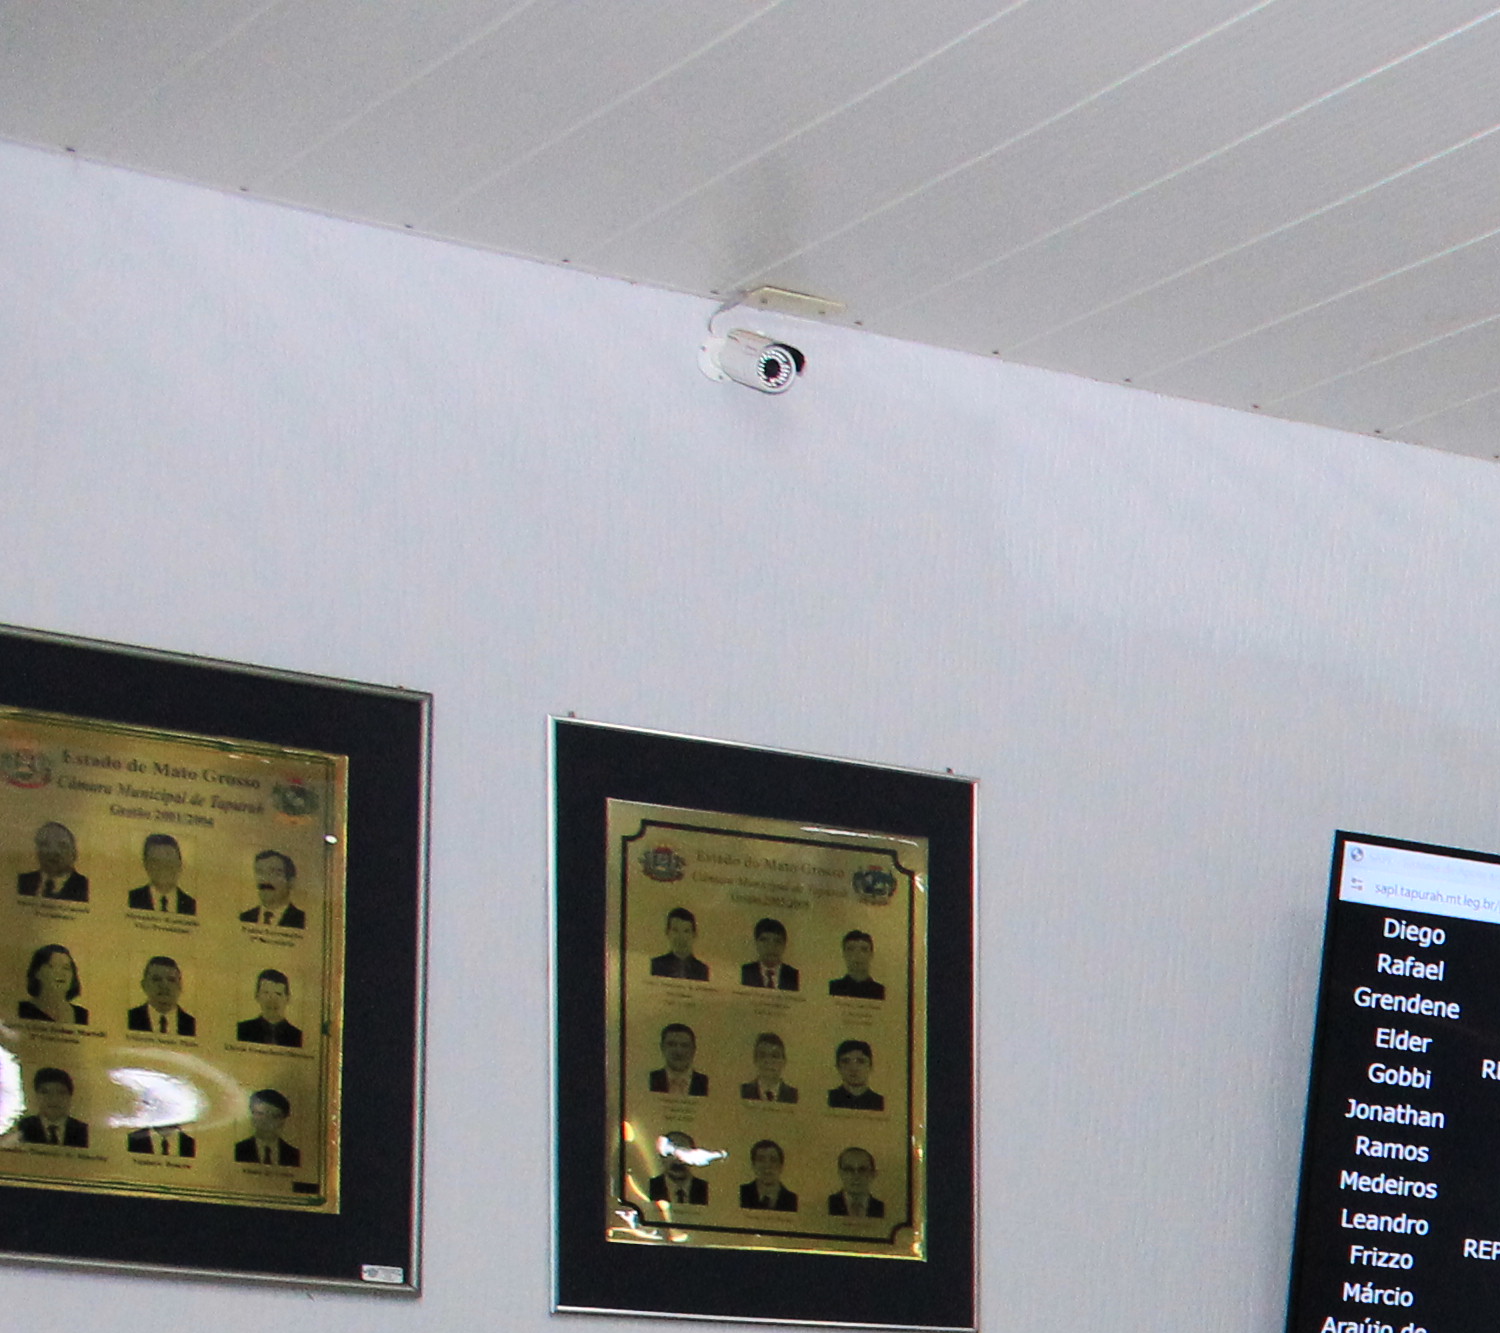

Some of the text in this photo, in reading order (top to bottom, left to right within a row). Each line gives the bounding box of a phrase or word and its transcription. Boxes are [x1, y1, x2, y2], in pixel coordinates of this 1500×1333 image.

[63, 750, 260, 789] Estado de Mato Grosso
[1383, 916, 1446, 948] Diego
[1376, 952, 1445, 981] Rafael
[1353, 985, 1460, 1019] Grendene
[1375, 1026, 1433, 1053] Elder
[1367, 1062, 1432, 1089] Gobbi
[1343, 1097, 1445, 1129] Jonathan
[1354, 1134, 1430, 1163] Ramos
[1339, 1169, 1438, 1199] Medeiros
[1340, 1207, 1429, 1236] Leandro
[1349, 1244, 1414, 1270] Frizzo
[1342, 1281, 1414, 1307] Márcio
